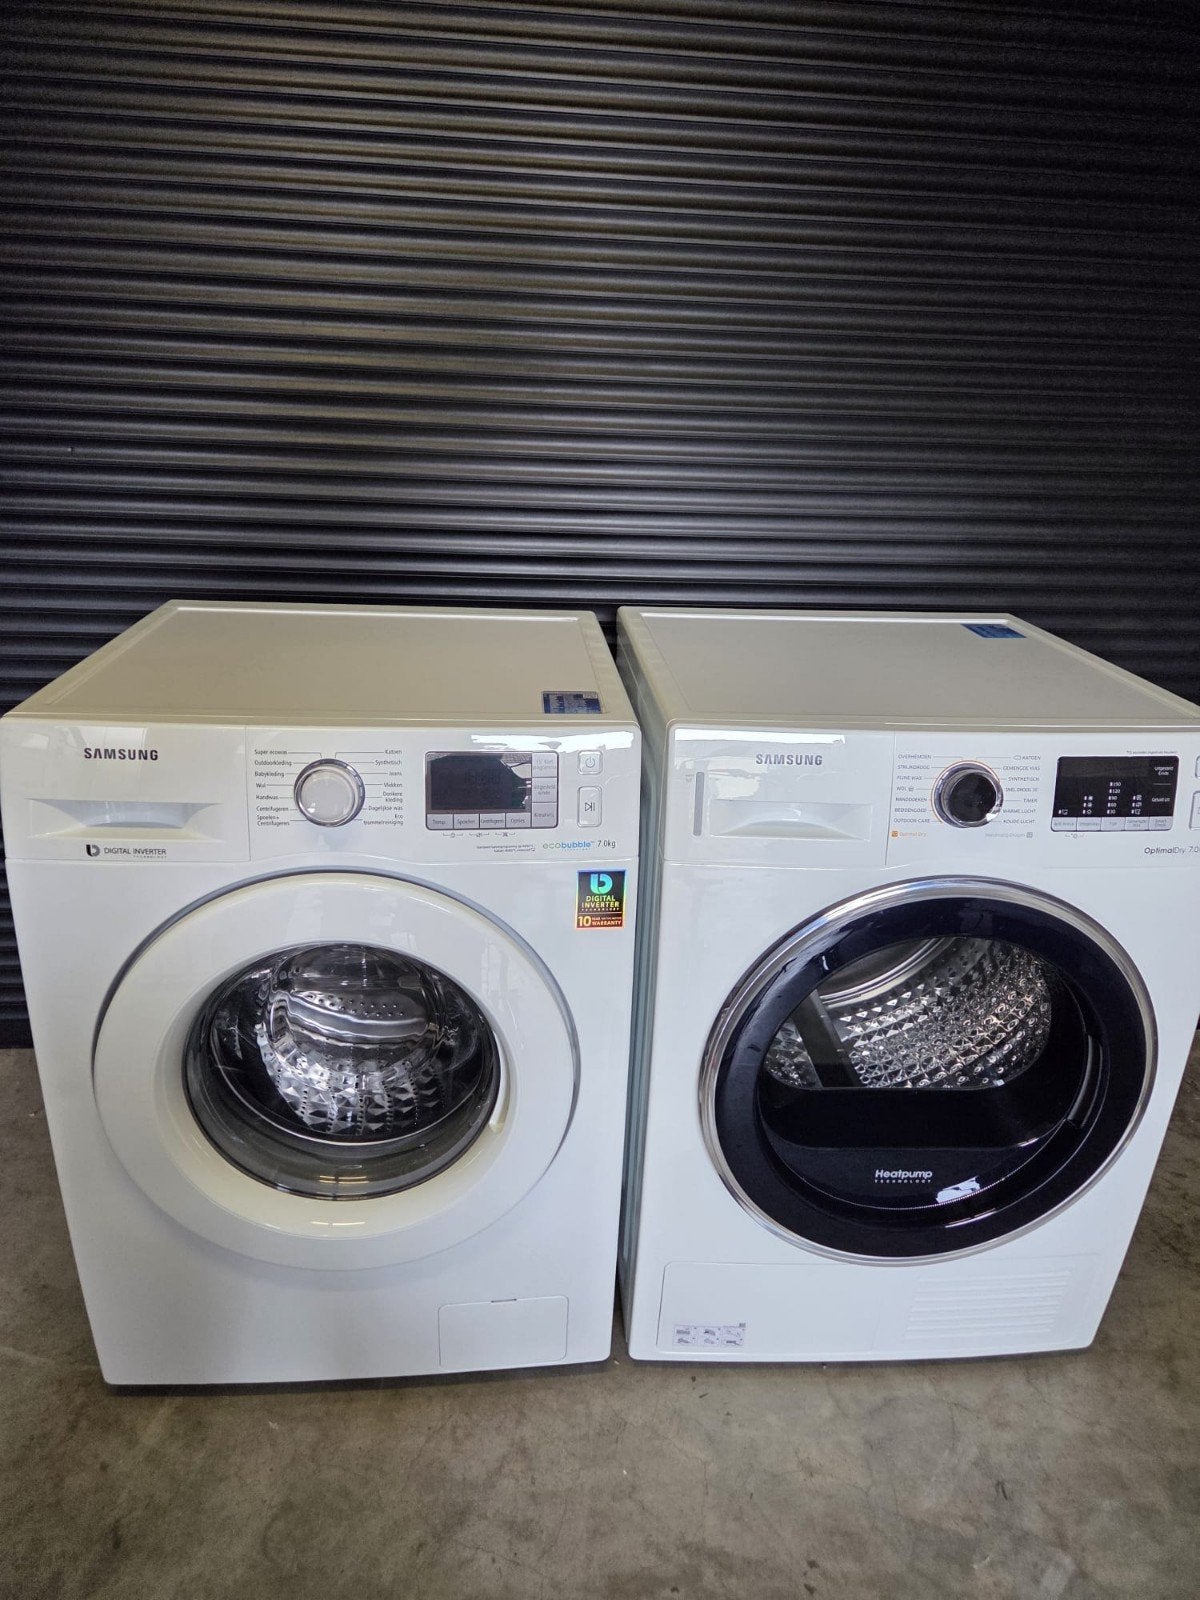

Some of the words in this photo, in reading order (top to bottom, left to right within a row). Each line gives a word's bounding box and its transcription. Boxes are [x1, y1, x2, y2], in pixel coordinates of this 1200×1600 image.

[84, 748, 158, 761] SAMSUNG
[755, 754, 823, 766] SAMSUNG
[597, 839, 616, 849] 7.0kg
[104, 847, 131, 855] DIGITAL
[578, 916, 591, 926] 10
[875, 1169, 933, 1179] Heatpump
